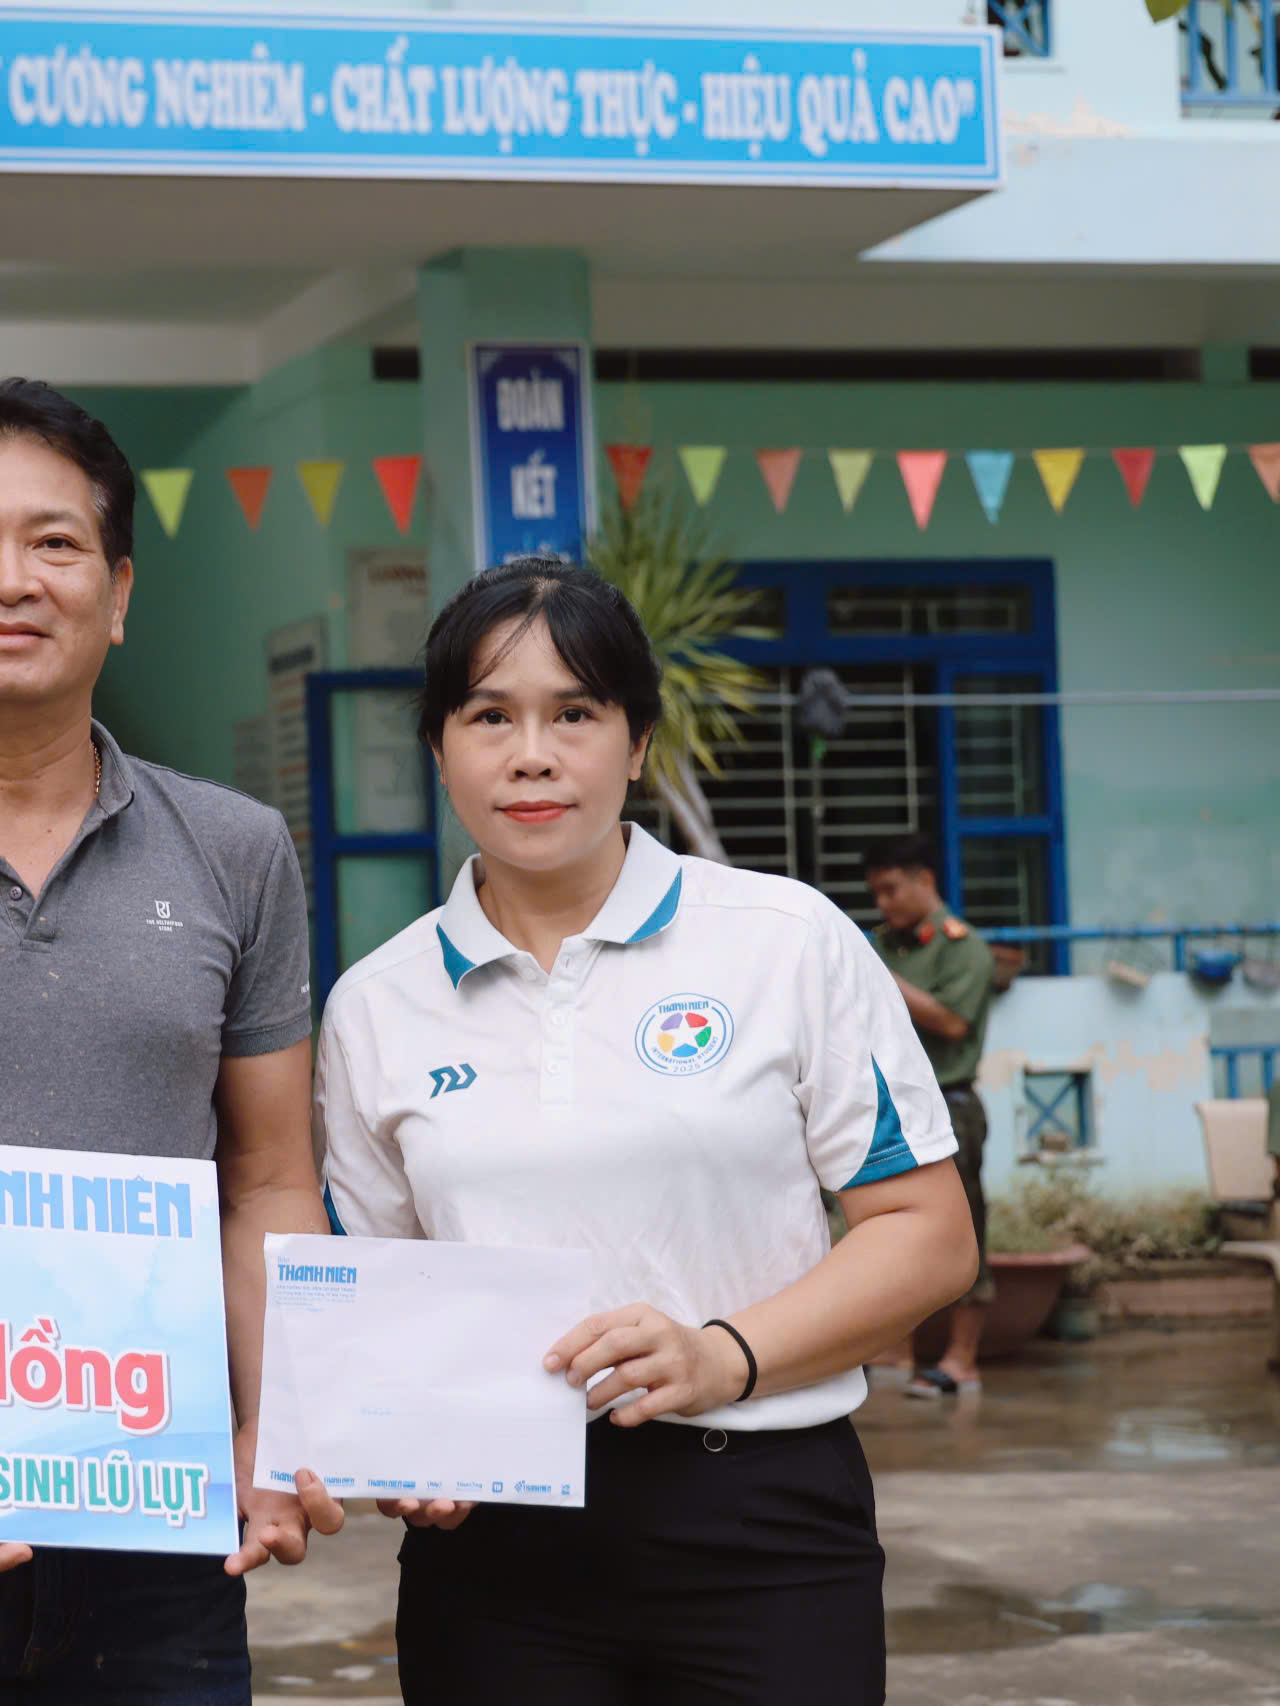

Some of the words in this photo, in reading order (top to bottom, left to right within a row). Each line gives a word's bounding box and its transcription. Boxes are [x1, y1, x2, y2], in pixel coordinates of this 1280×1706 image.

[9, 45, 147, 130] CƯƠNG
[154, 42, 307, 131] NGHIÊM
[331, 34, 433, 134] CHẤT
[442, 55, 570, 153] LƯỢNG
[575, 60, 678, 155] THỰC
[702, 54, 791, 158] HIỆU
[797, 49, 877, 155] QUẢ
[510, 448, 557, 519] KẾT
[71, 1173, 194, 1239] NIÊN
[277, 1264, 324, 1283] THANH
[87, 1454, 131, 1510] LŨ
[142, 1464, 206, 1524] LỤT
